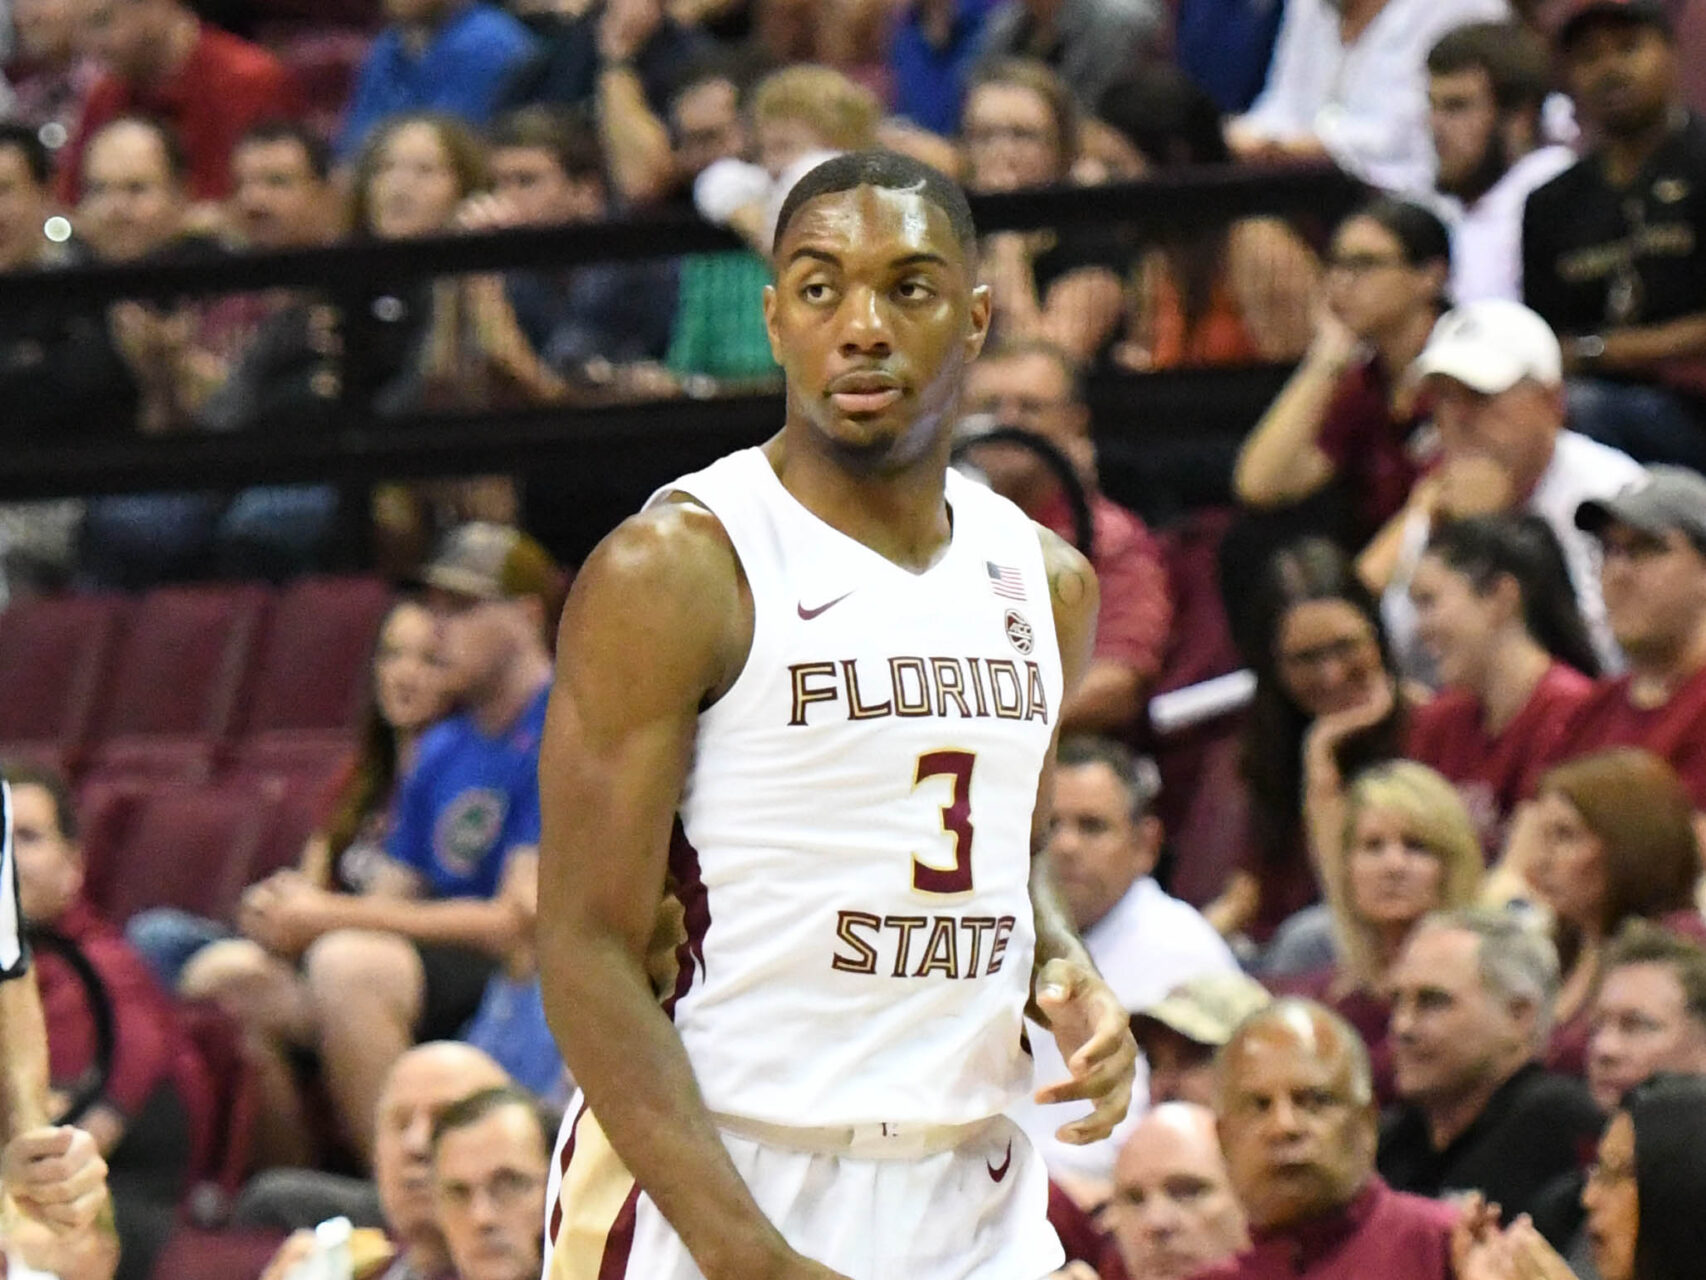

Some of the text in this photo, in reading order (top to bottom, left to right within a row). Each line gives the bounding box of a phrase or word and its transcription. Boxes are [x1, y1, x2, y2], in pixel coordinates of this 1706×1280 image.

[787, 657, 1048, 726] FLORIDA
[911, 746, 977, 897] 3
[832, 910, 1016, 979] STATE
